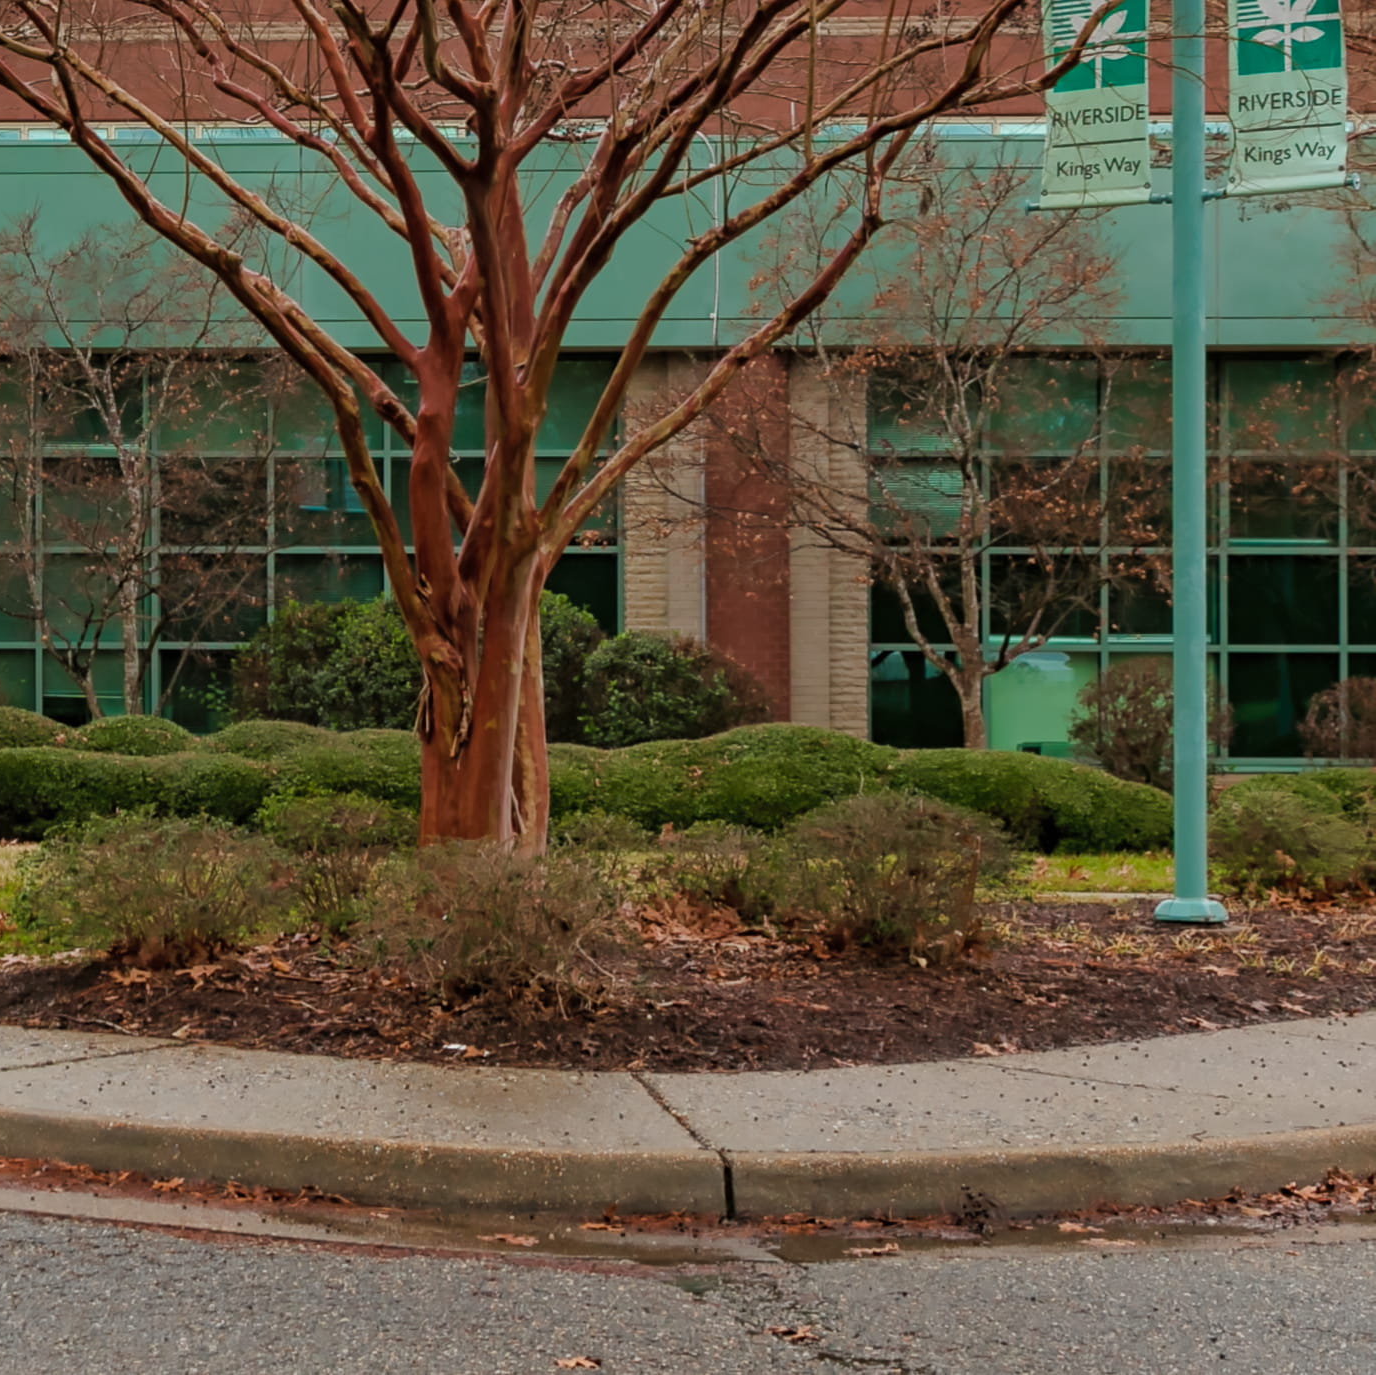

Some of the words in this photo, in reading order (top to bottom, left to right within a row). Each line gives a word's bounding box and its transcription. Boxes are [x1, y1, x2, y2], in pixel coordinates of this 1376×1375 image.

[1237, 88, 1342, 113] RIVERSIDE
[1052, 104, 1146, 127] RIVERSIDE
[1244, 146, 1292, 165] Kings
[1295, 141, 1337, 161] Way
[1057, 161, 1101, 180] Kings
[1104, 156, 1141, 176] Way
